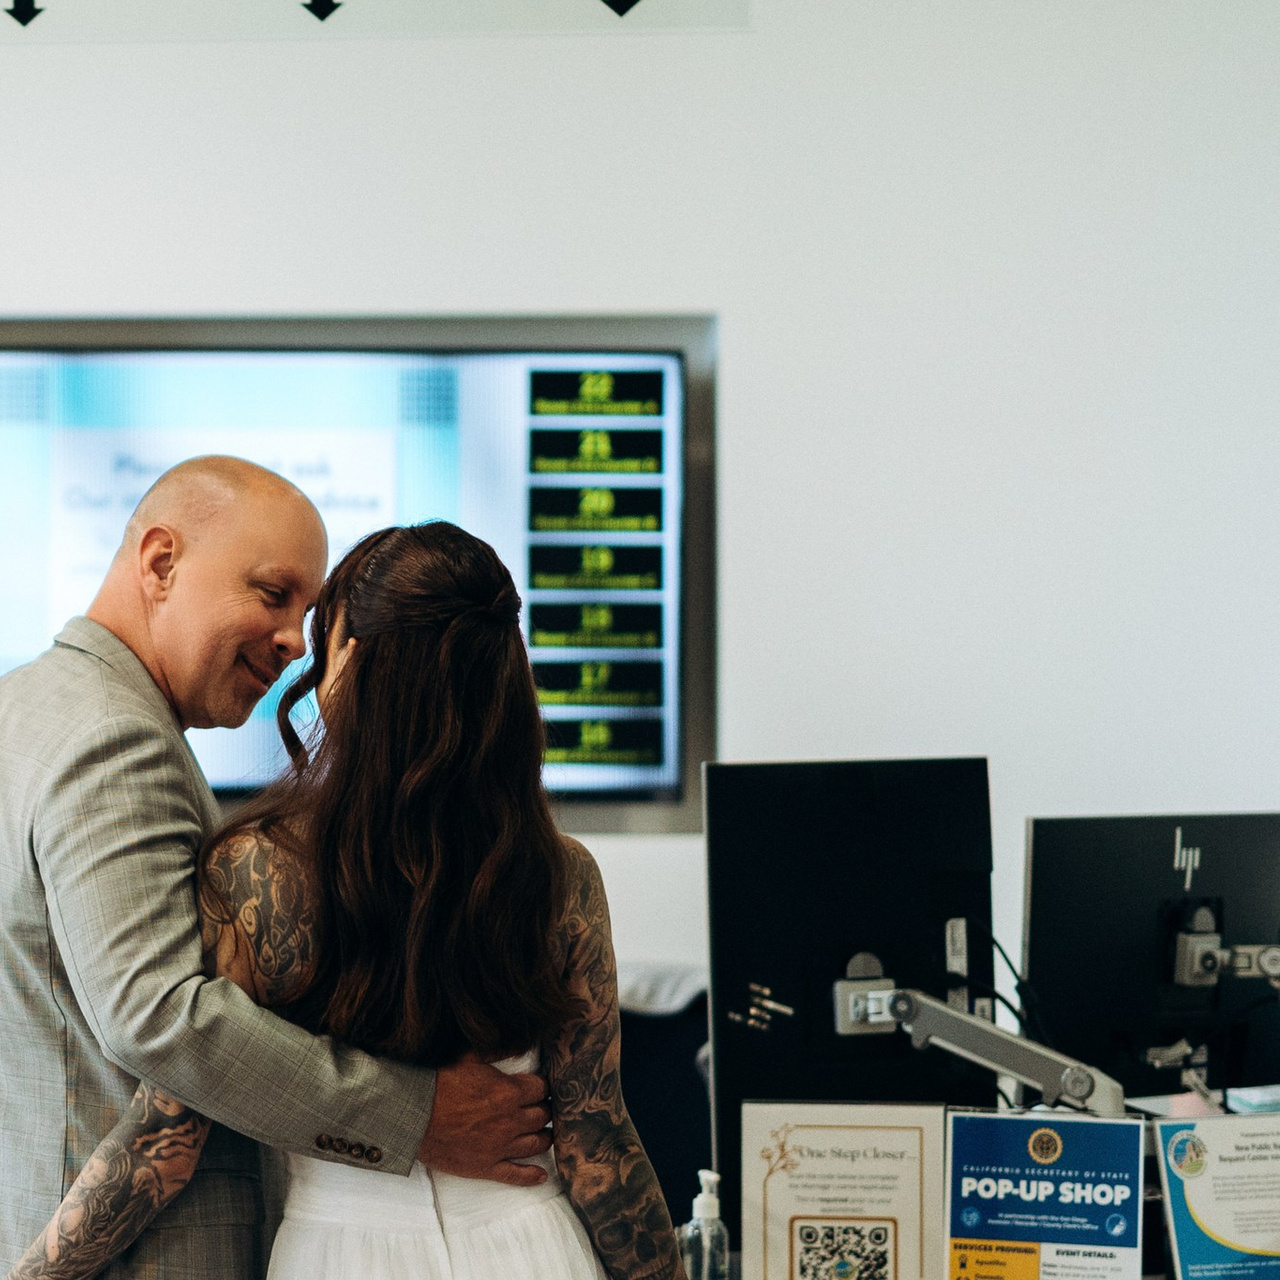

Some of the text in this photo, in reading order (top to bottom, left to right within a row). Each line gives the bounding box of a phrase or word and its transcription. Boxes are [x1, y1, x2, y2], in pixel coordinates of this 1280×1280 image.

[1174, 826, 1200, 892] hp
[962, 1164, 1129, 1180] CALIFORNIA SECRETARY OF STATE
[962, 1177, 1131, 1206] POP-UP SHOP
[1056, 1249, 1080, 1257] EVENT
